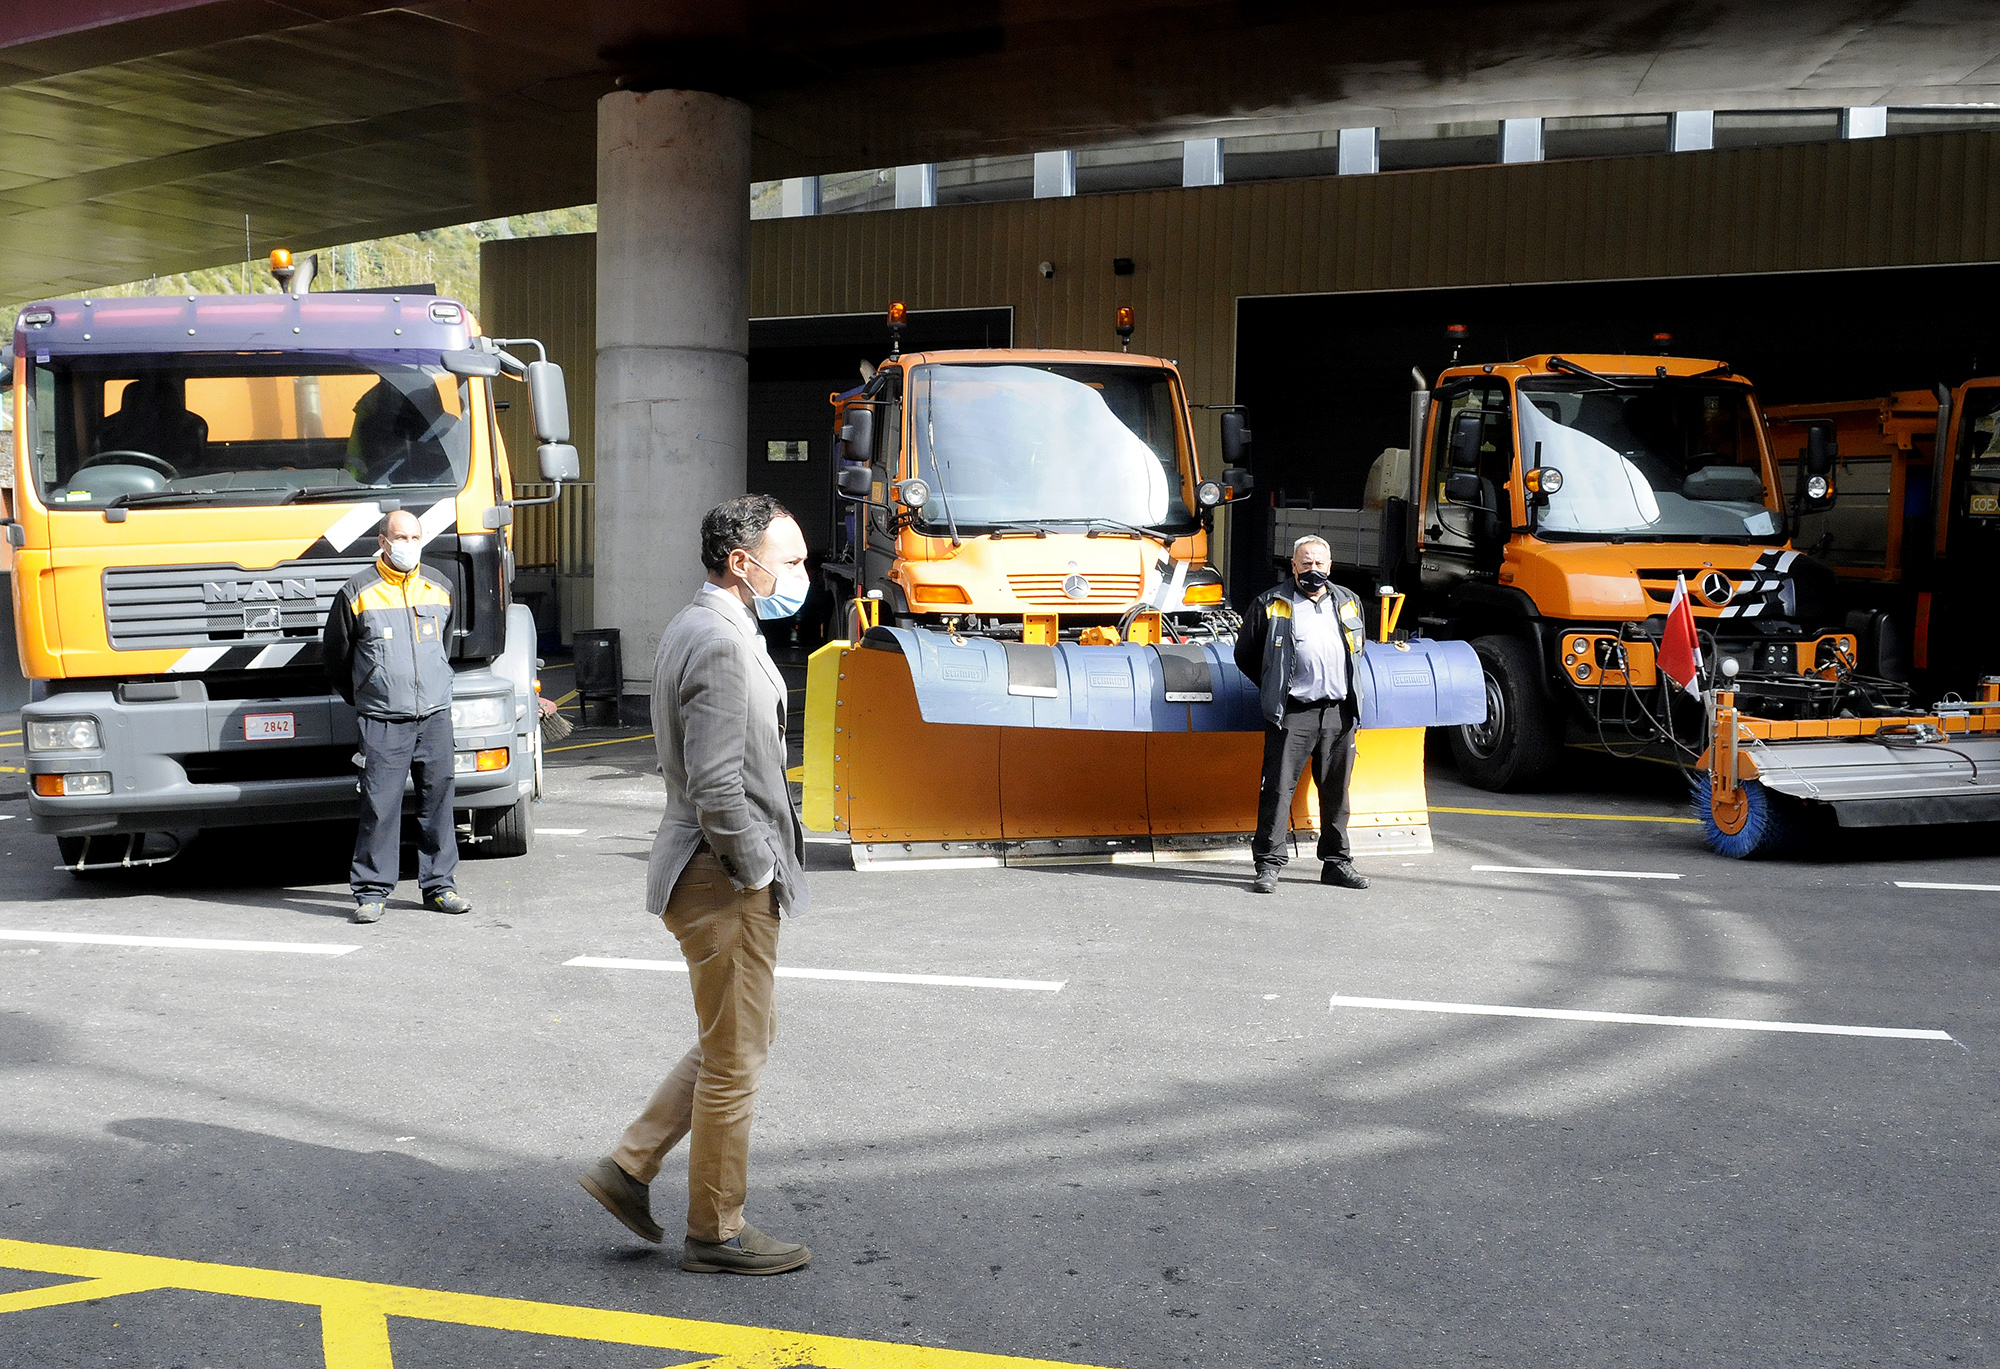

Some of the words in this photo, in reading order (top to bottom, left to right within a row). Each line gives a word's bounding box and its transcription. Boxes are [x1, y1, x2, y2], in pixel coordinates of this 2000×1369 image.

[203, 578, 316, 602] MAN
[945, 669, 981, 679] SCHMIDT
[1092, 676, 1127, 686] SCHMIDT
[263, 720, 289, 733] 2842
